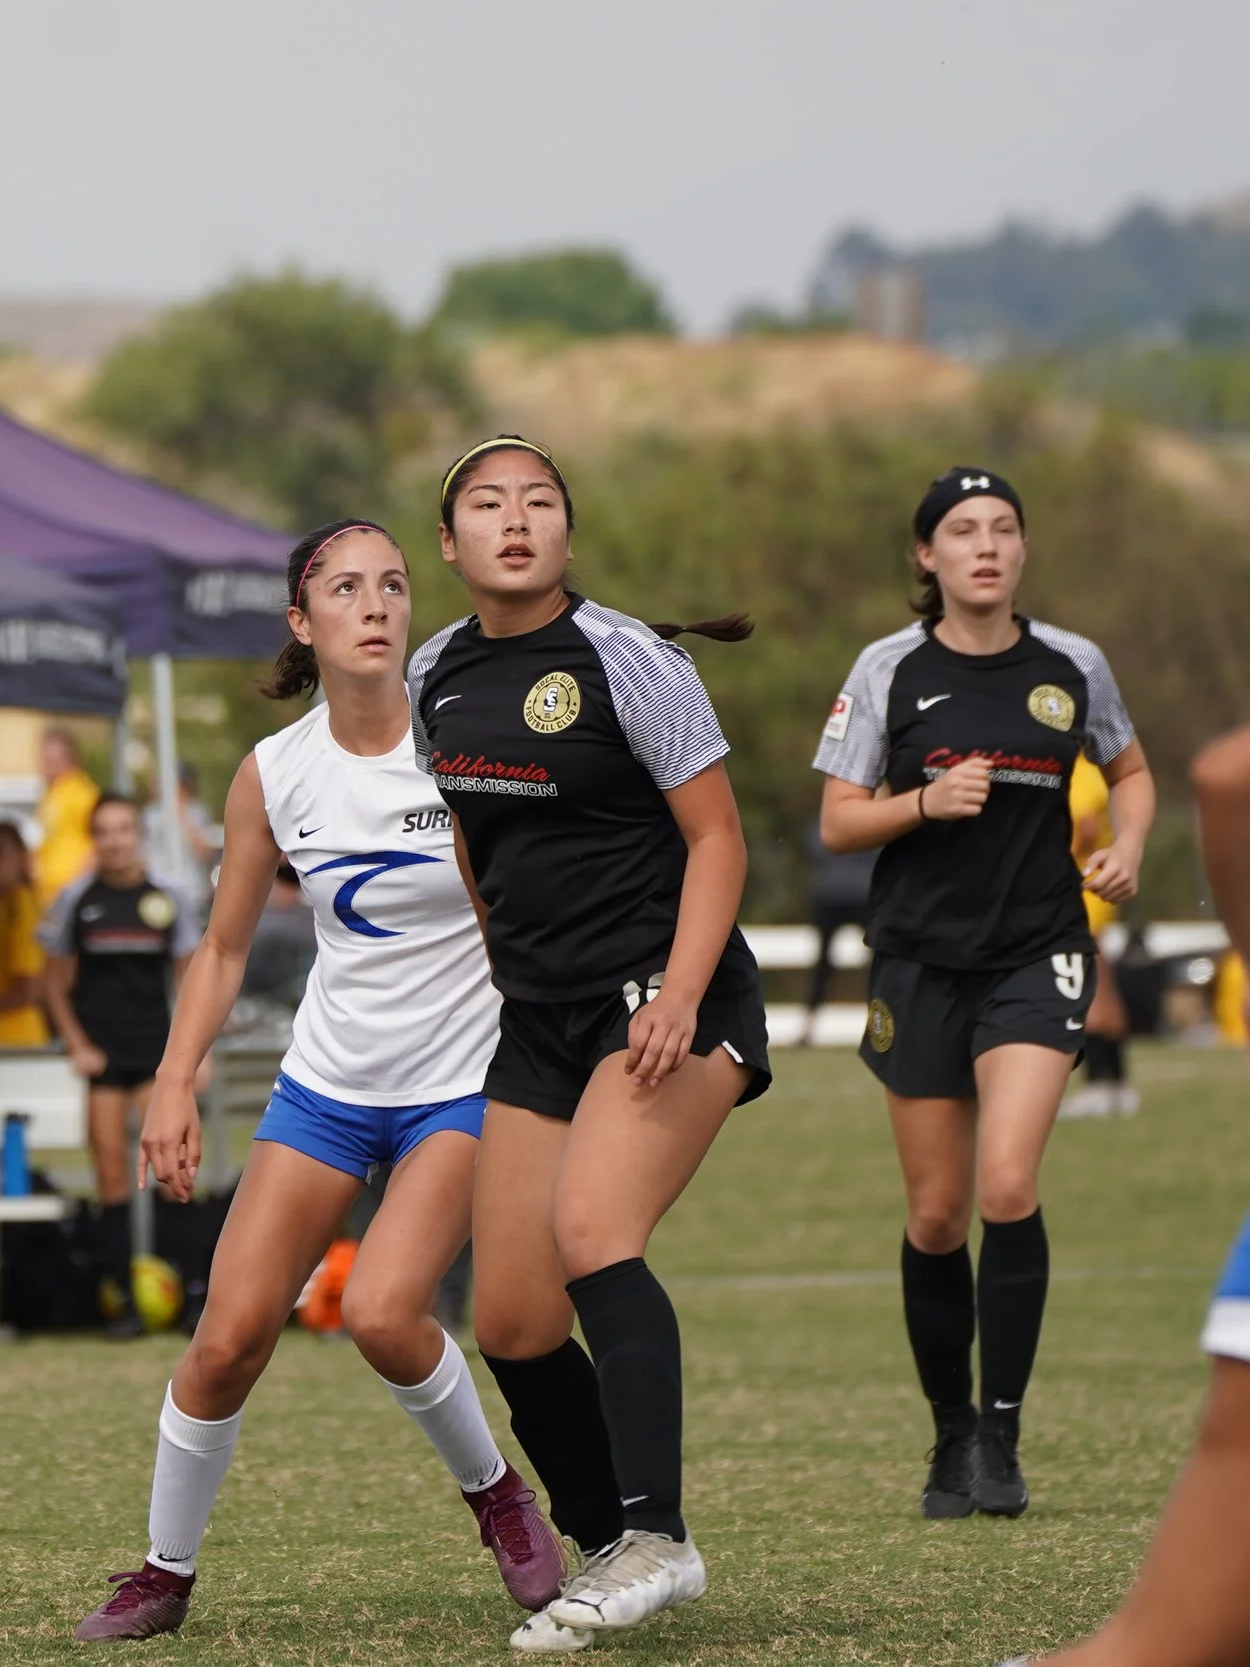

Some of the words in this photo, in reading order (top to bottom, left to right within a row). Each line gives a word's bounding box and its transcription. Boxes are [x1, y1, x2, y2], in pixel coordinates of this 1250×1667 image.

[560, 674, 576, 692] ELITE
[526, 706, 555, 731] FOOTBALL
[557, 709, 577, 729] CLUB
[402, 809, 452, 833] SUR
